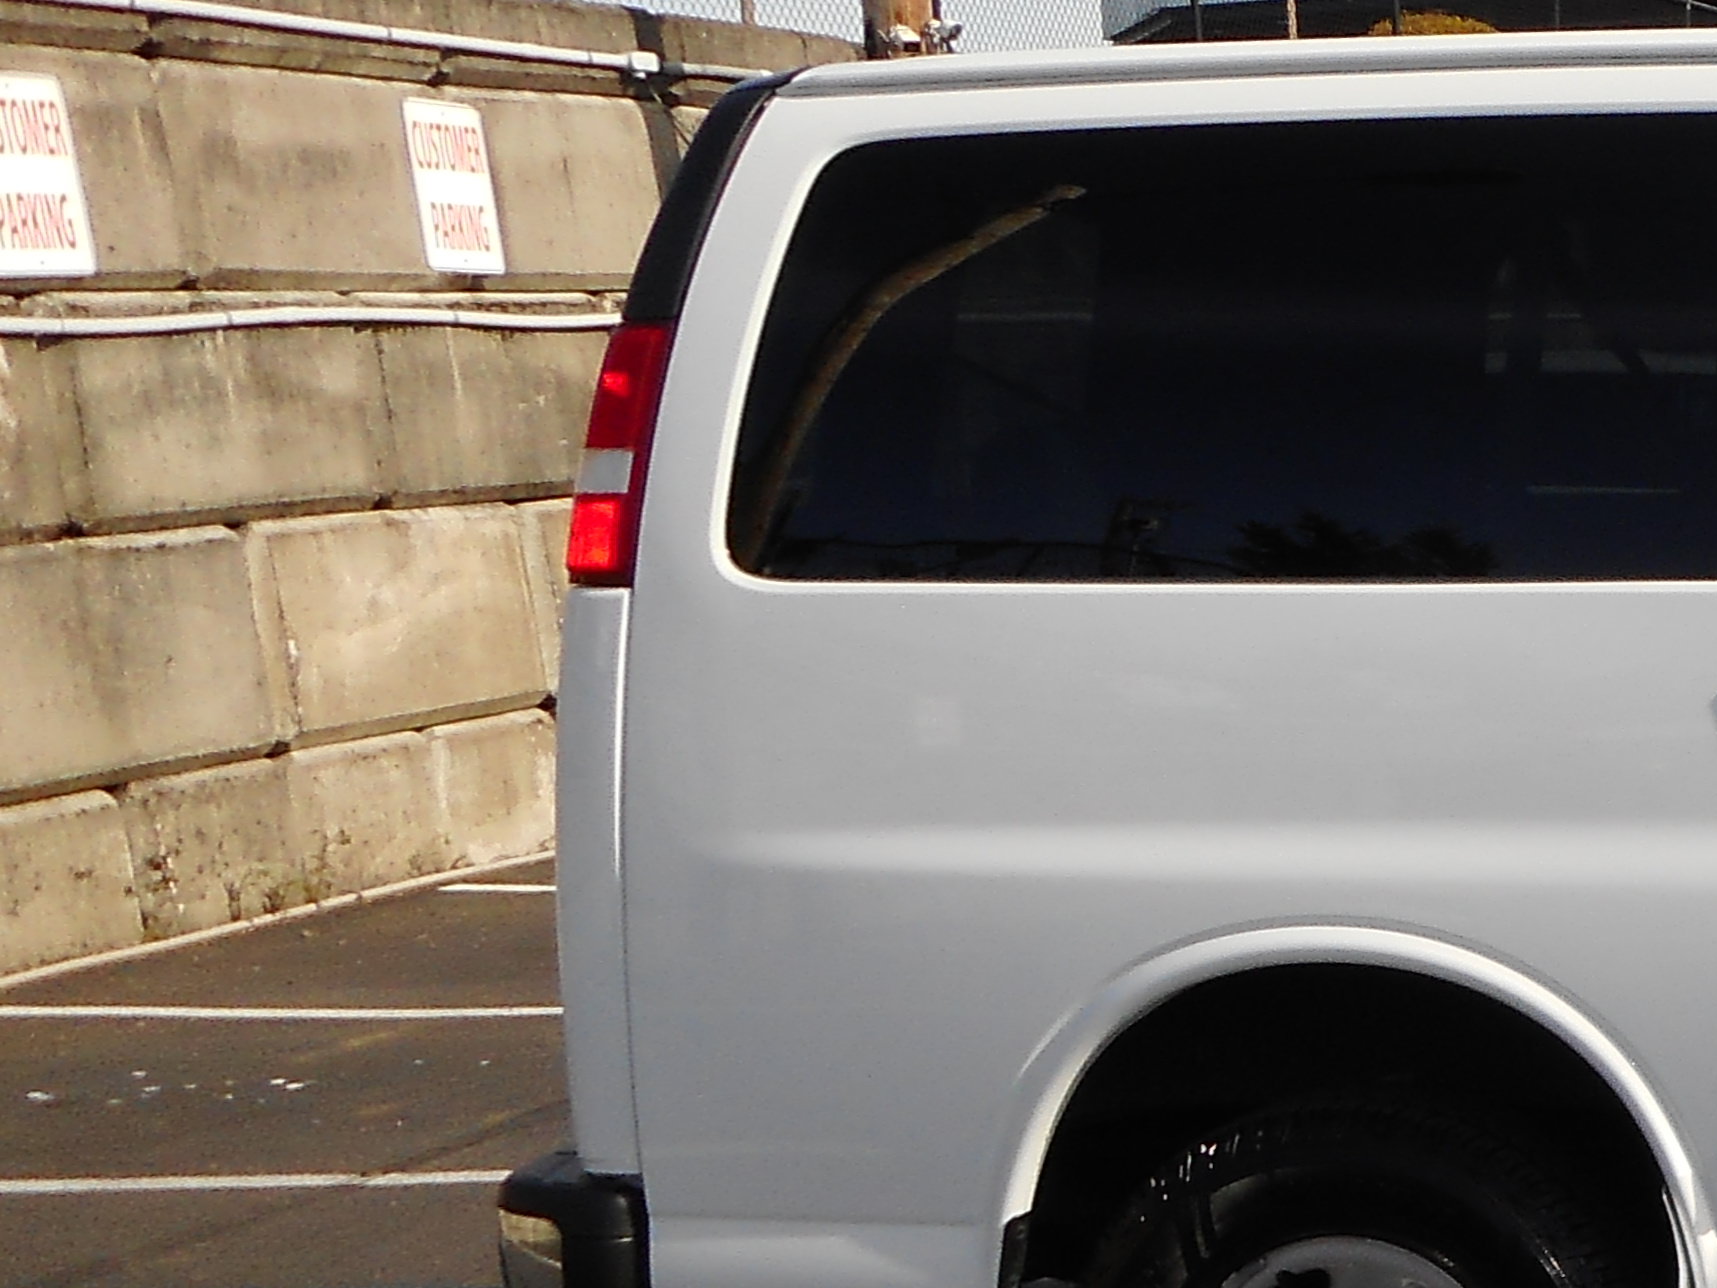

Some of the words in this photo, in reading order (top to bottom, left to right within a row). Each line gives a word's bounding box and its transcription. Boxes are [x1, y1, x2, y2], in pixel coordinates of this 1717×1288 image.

[0, 98, 68, 156] TOMER
[412, 120, 486, 174] CUSTOMER
[430, 201, 491, 253] PARKING
